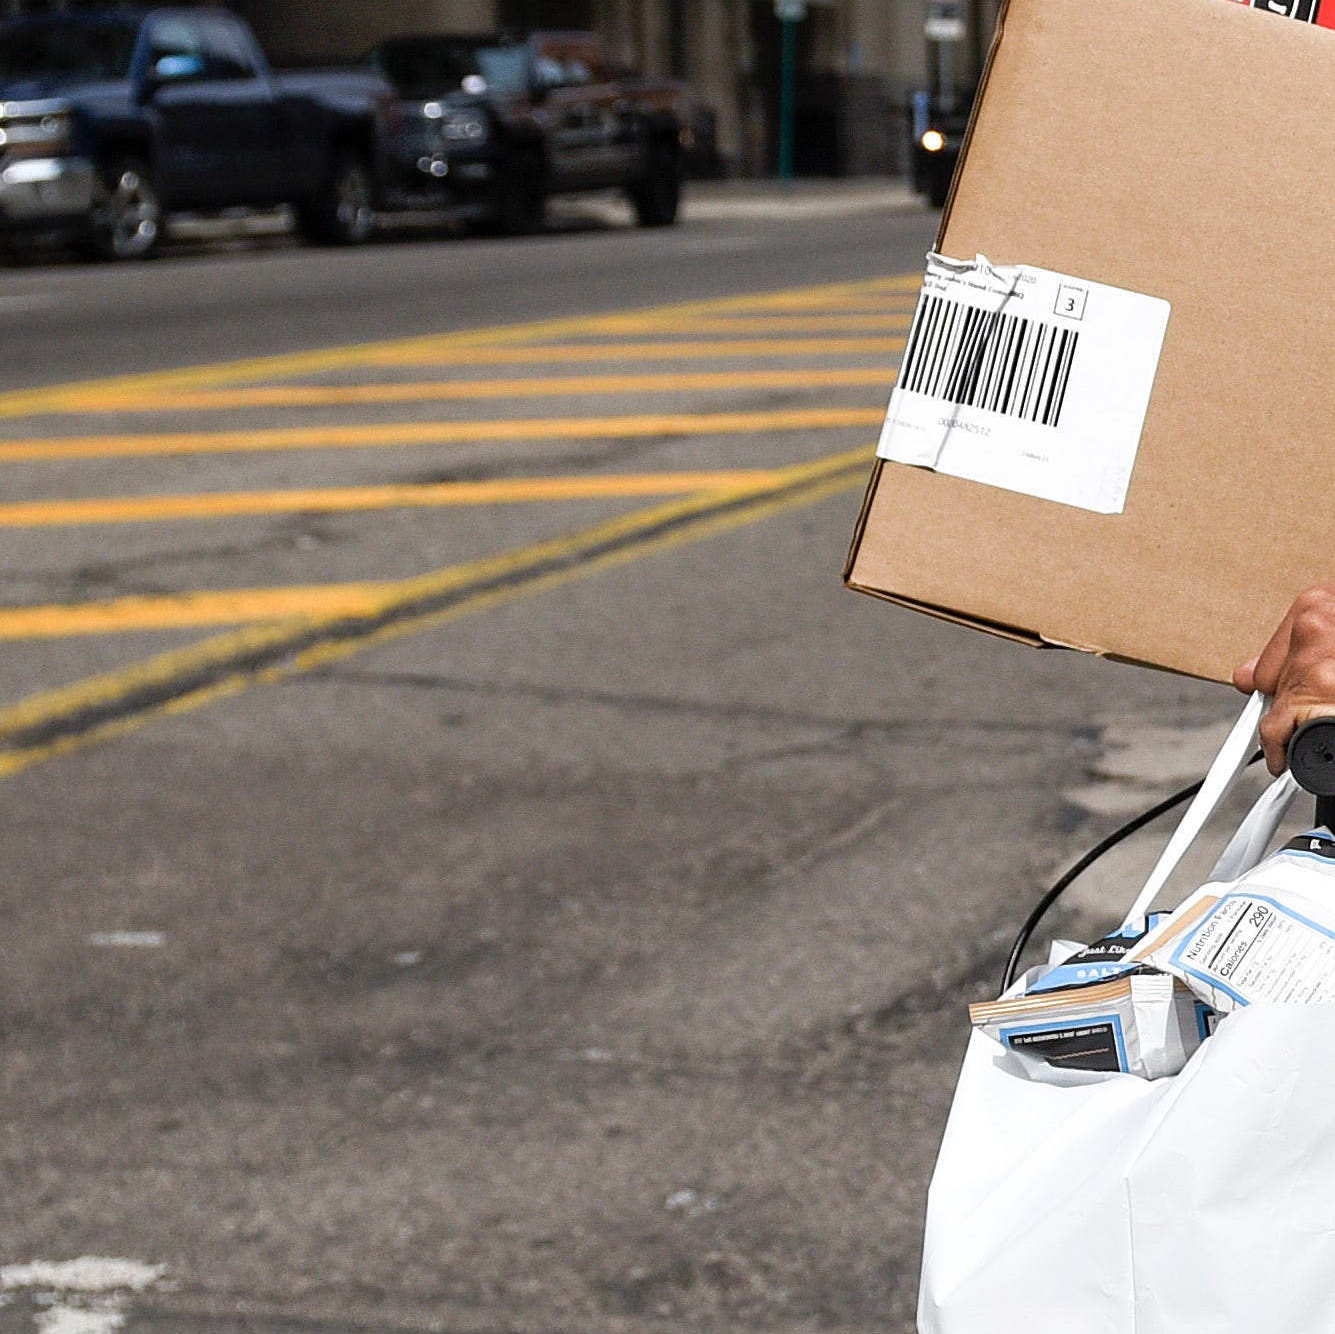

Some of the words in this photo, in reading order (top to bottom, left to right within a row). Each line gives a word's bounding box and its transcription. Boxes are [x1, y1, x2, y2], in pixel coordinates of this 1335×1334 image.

[1065, 298, 1076, 312] 3
[1249, 906, 1269, 927] 290
[1186, 919, 1219, 960] Nutrition
[1078, 945, 1106, 958] Just
[1220, 941, 1247, 976] Calories
